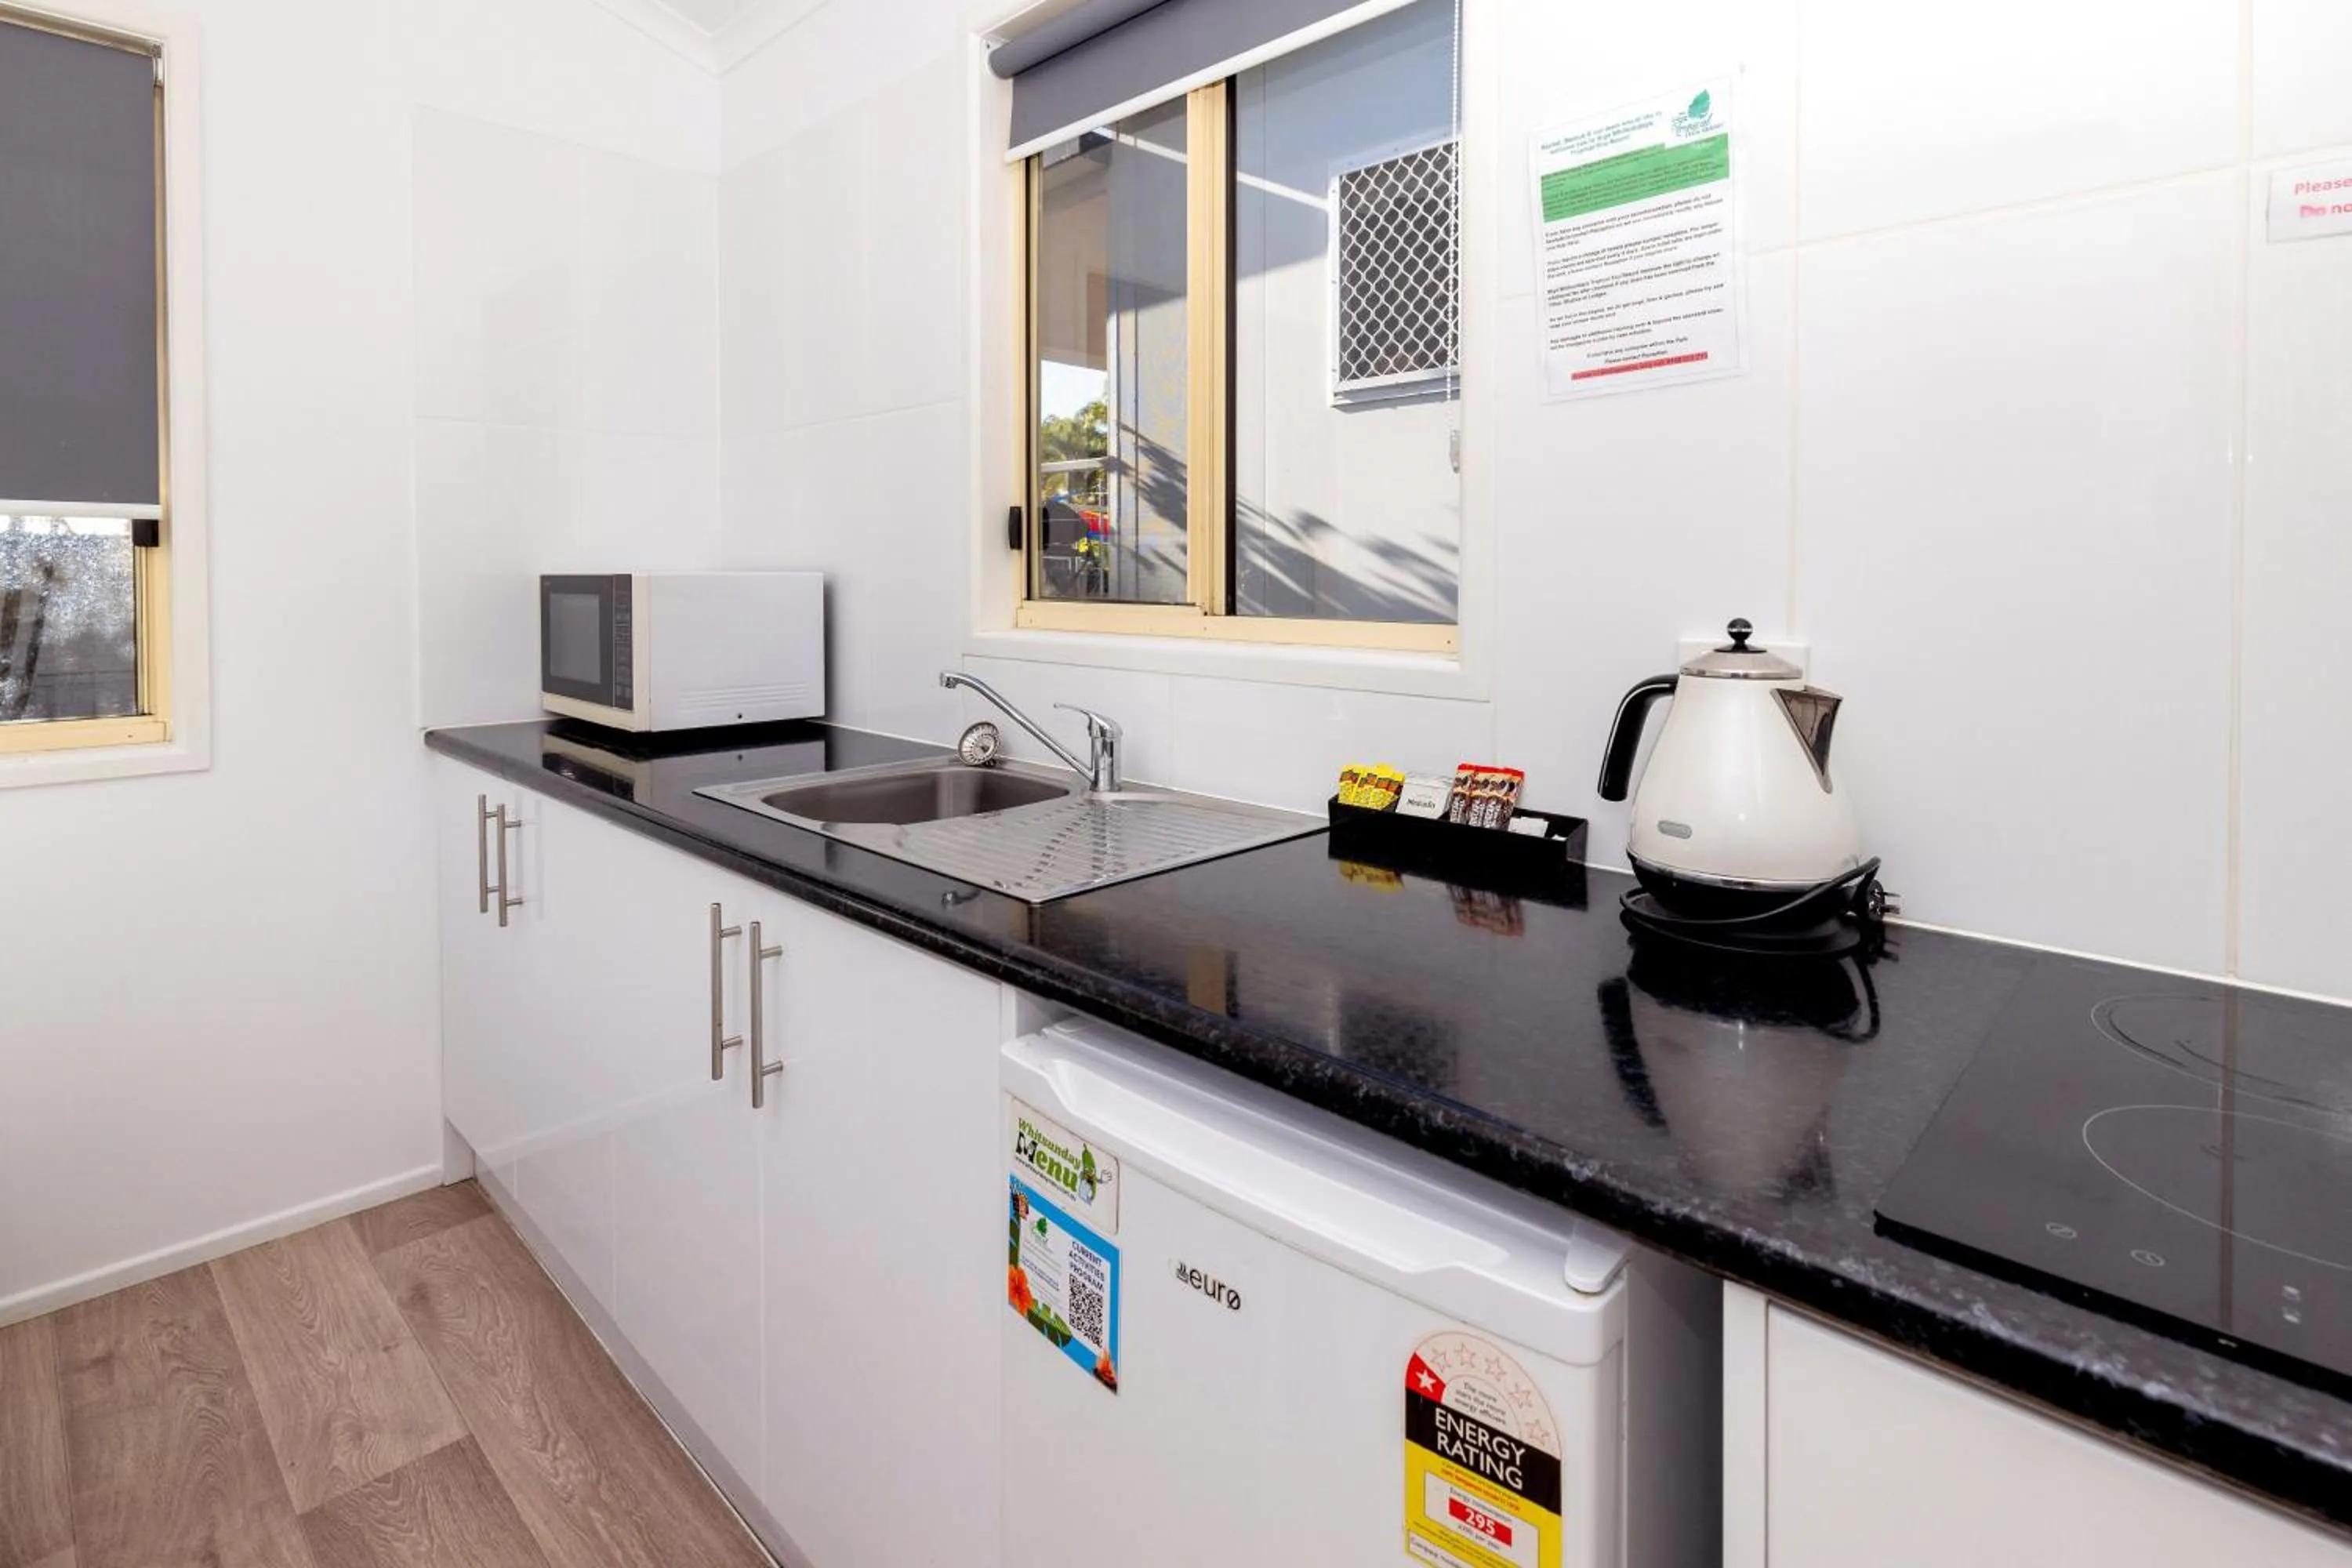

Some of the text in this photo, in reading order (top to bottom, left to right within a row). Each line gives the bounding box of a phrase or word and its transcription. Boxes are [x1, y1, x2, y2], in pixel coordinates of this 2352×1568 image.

[2294, 178, 2352, 194] Please
[1015, 1131, 1079, 1192] Menu
[1018, 1116, 1081, 1171] Whitsunday
[1435, 1407, 1525, 1466] ENERGY
[1437, 1432, 1523, 1490] RATING
[1465, 1508, 1496, 1536] 295
